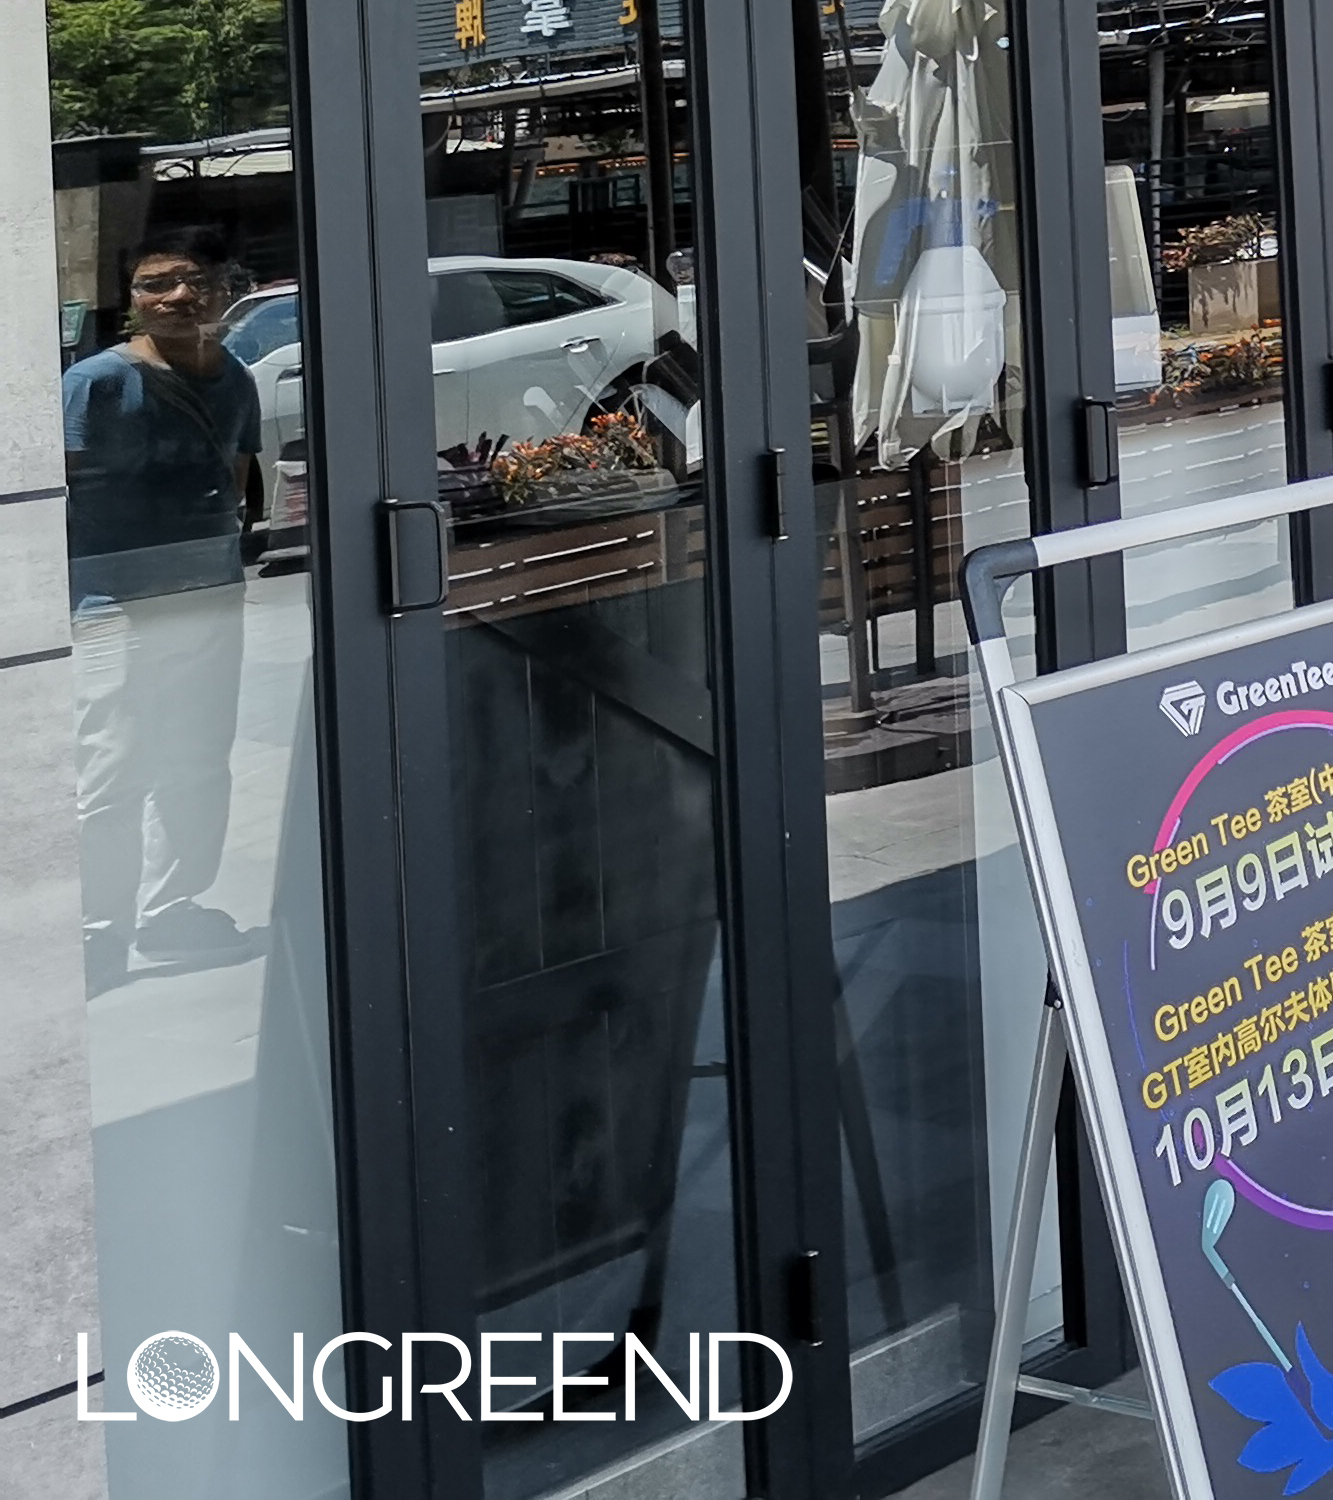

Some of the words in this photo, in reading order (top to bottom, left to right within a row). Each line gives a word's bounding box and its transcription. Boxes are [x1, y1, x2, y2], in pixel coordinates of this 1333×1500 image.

[1126, 832, 1210, 888] Green
[1210, 807, 1262, 847] Tee
[1154, 976, 1243, 1042] Green
[1243, 946, 1299, 992] Tee
